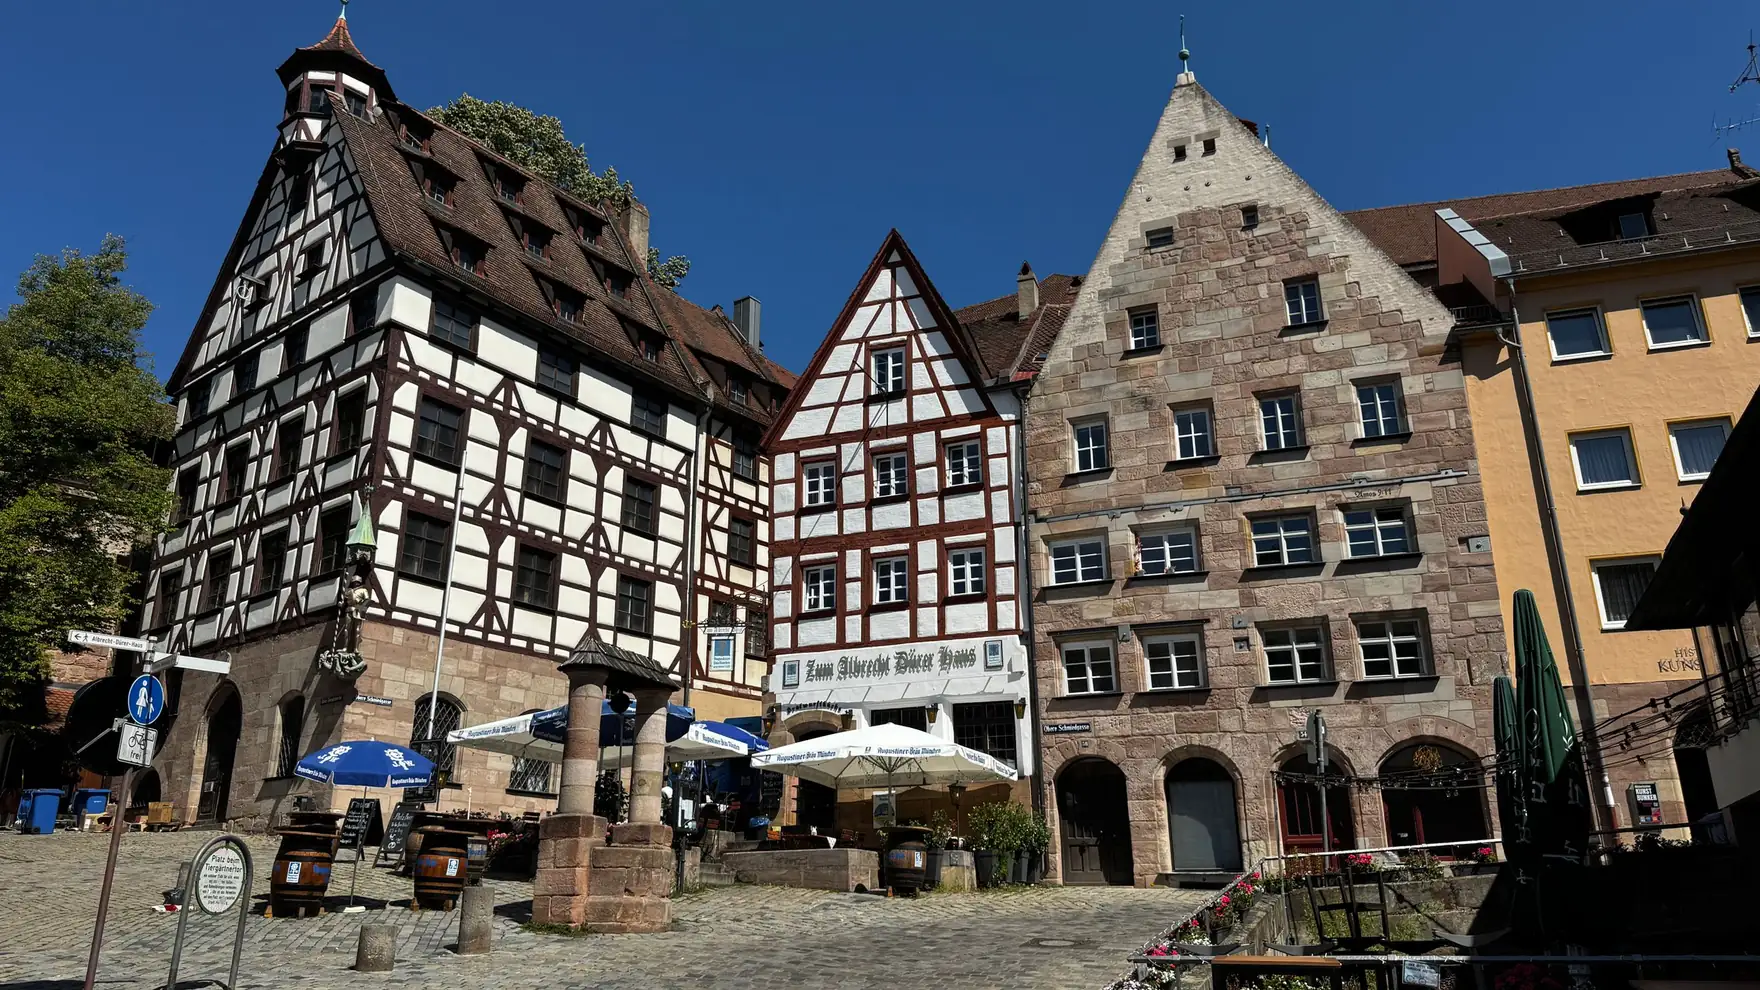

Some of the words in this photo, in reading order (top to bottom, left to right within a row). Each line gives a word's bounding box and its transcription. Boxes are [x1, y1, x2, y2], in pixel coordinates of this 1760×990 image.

[1354, 490, 1376, 498] Amos
[91, 635, 143, 649] Albrecht-Dürer-Haus
[1674, 646, 1697, 658] HIS
[805, 659, 834, 683] Zum
[836, 652, 890, 682] Albrecht
[893, 648, 935, 676] Dürer
[937, 645, 977, 676] Haus
[1058, 723, 1090, 732] Schmiedgasse
[130, 750, 142, 760] frei
[212, 854, 226, 863] Platz
[227, 855, 239, 863] beim
[205, 863, 243, 873] Tiergärtnertor
